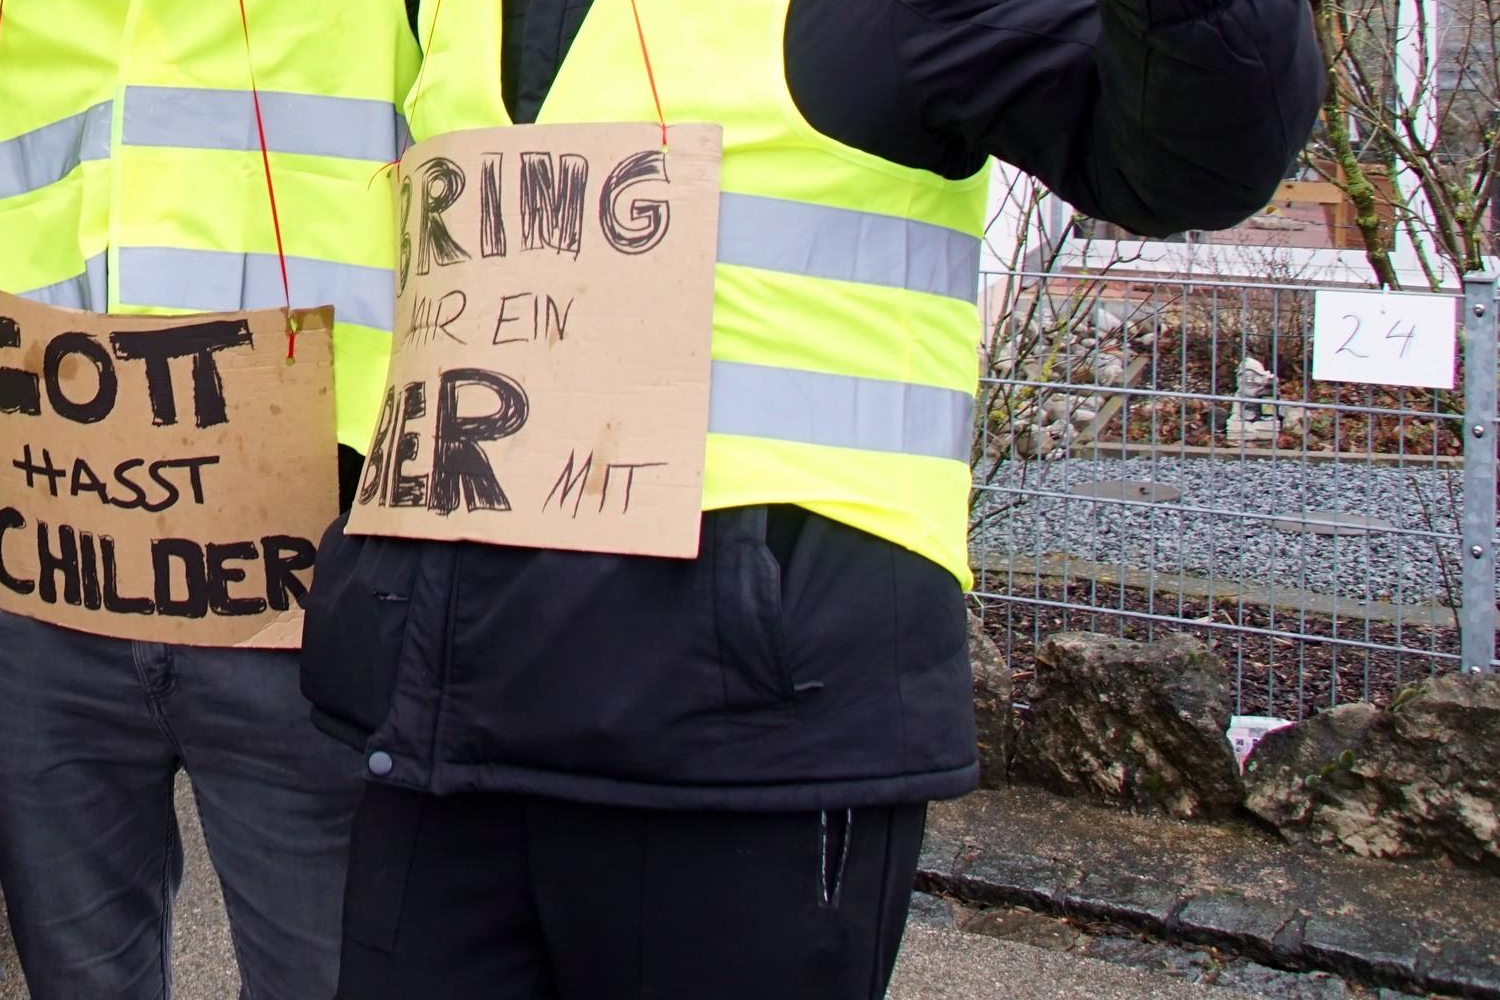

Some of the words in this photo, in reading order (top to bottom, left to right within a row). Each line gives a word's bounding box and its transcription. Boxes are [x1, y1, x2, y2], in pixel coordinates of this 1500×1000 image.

[492, 292, 574, 346] EIN
[1336, 314, 1416, 359] 24
[13, 444, 220, 512] HASST
[542, 448, 669, 518] MIT
